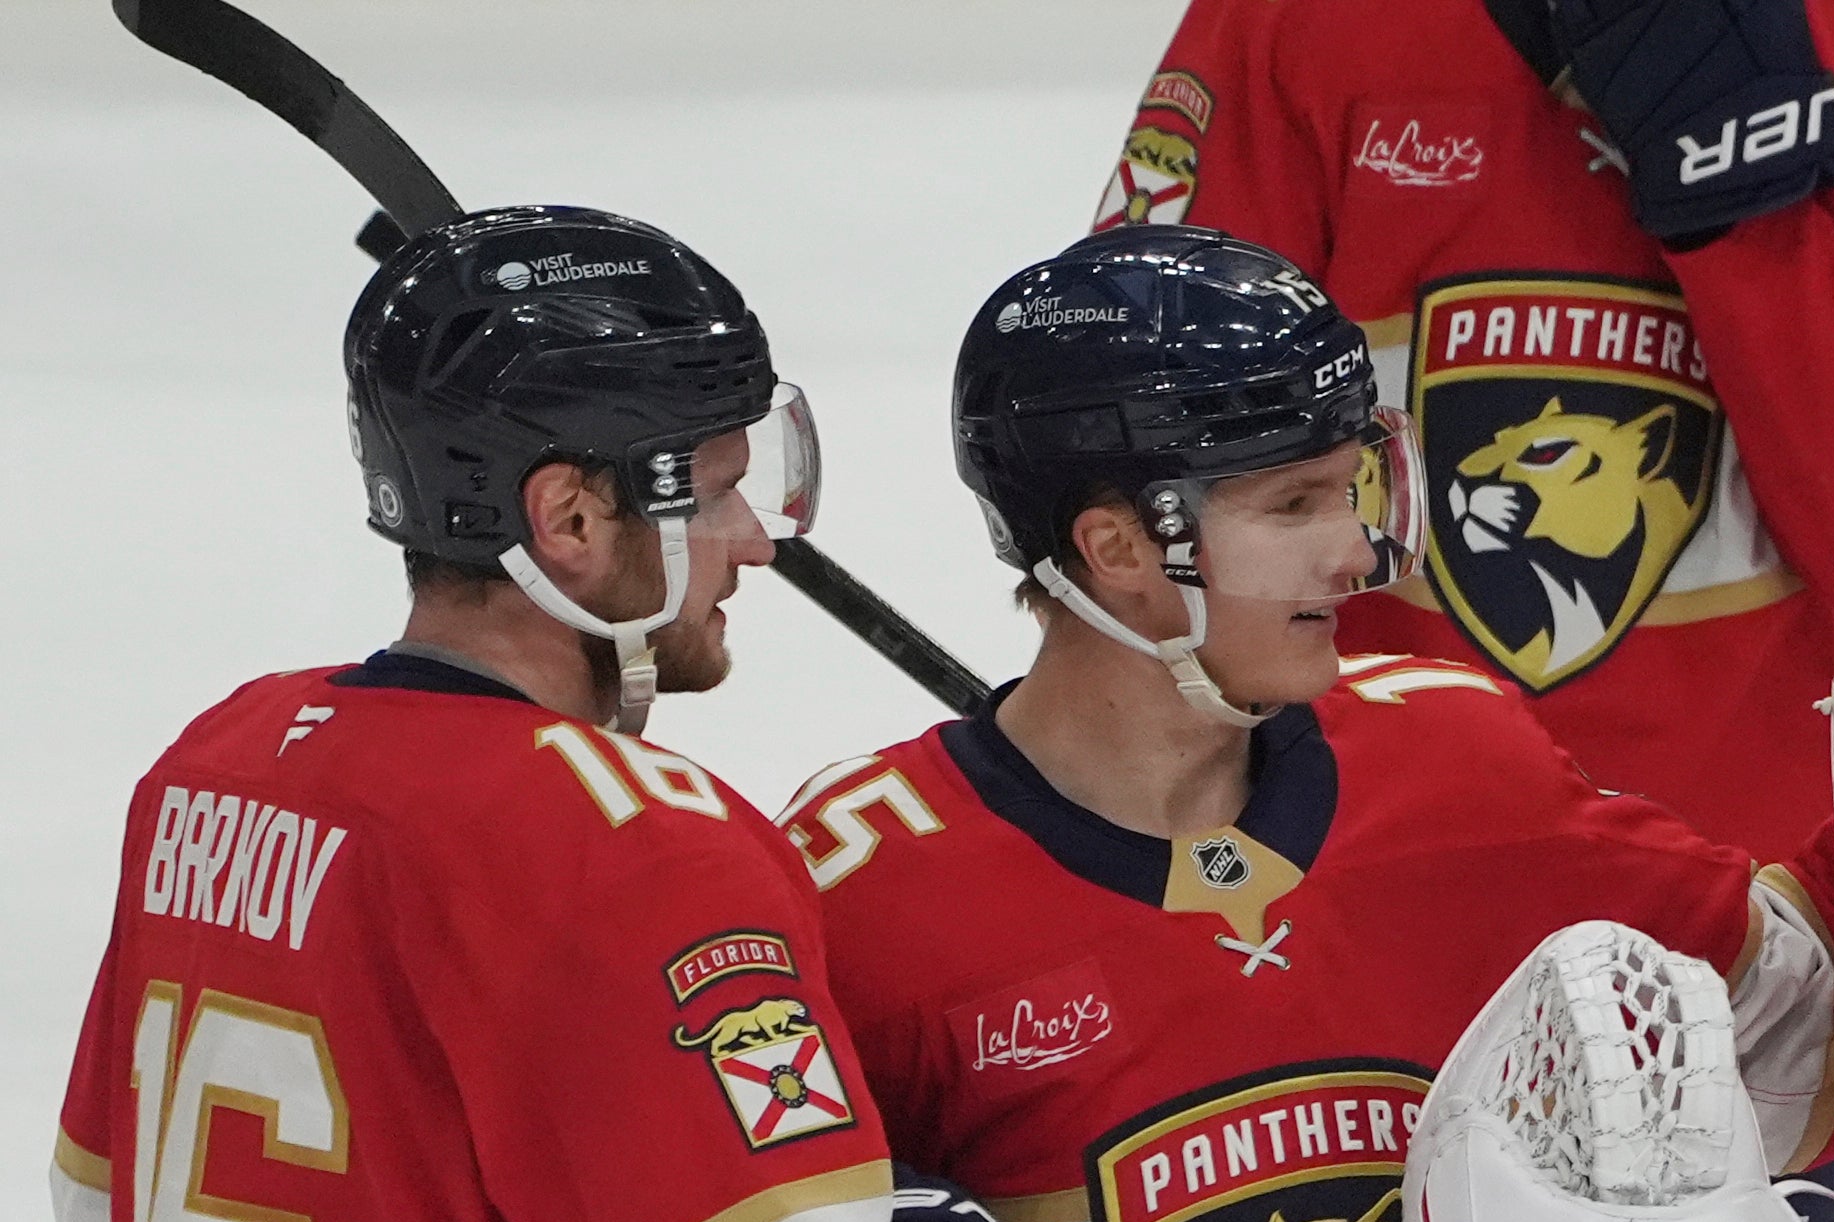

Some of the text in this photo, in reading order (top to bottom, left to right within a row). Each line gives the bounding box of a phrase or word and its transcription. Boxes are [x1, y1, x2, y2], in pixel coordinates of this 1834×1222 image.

[529, 253, 574, 272] VISIT
[533, 260, 652, 287] LAUDERDALE
[1022, 307, 1130, 330] LAUDERDALE
[1025, 296, 1062, 314] VISIT
[1314, 343, 1364, 390] CCM
[1165, 567, 1198, 577] CCM
[534, 721, 729, 829] 16
[143, 785, 349, 951] BARKOV
[684, 943, 778, 984] FLORIDA
[973, 994, 1113, 1071] LaCroix
